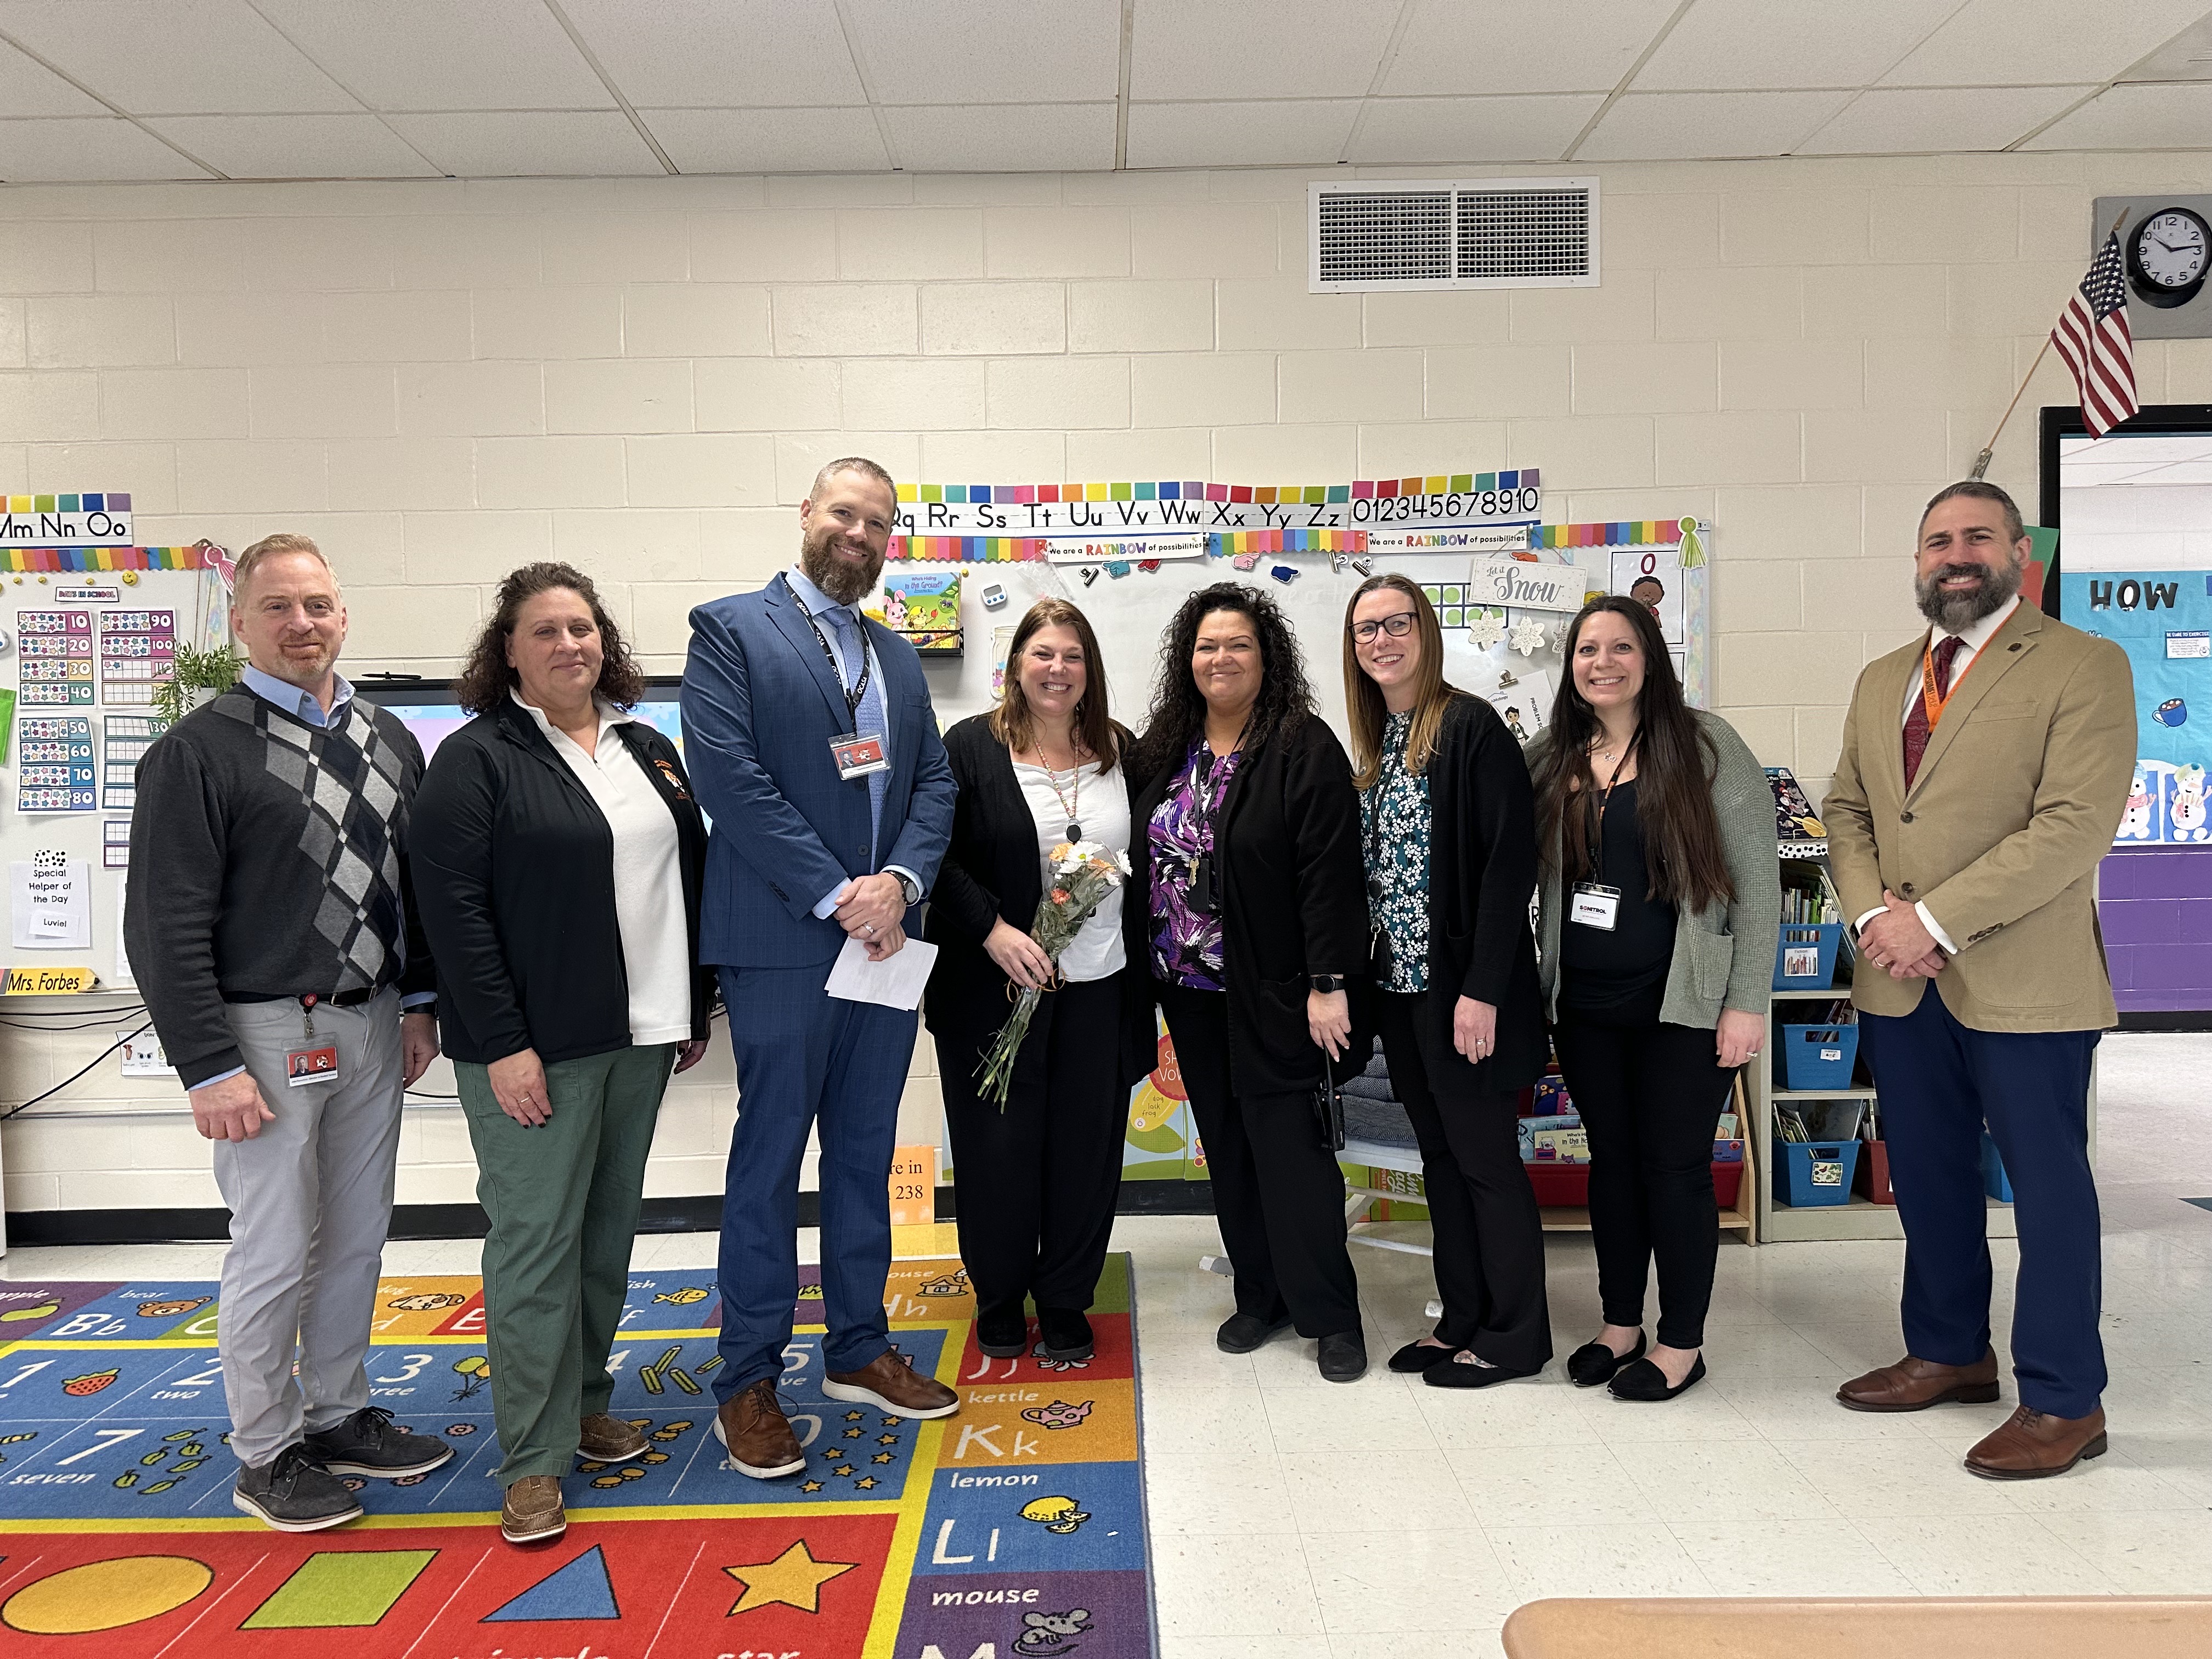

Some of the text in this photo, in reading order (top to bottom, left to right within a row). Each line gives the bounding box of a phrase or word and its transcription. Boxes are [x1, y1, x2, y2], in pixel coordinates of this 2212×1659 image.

[2153, 221, 2160, 229] 11
[2165, 217, 2177, 226] 12
[2142, 232, 2152, 240] 10
[2191, 232, 2199, 240] 2
[2138, 247, 2147, 255] 9
[2142, 261, 2151, 270] 8
[2190, 261, 2198, 269] 4
[2151, 272, 2160, 281] 7
[2165, 276, 2174, 285] 6
[2179, 272, 2187, 281] 5
[929, 503, 960, 527] Rr
[977, 504, 1007, 528] Ss
[1023, 503, 1052, 527] Tt
[1070, 503, 1103, 526] Uu
[1117, 501, 1148, 525] Vv
[1159, 500, 1201, 524] Ww
[1211, 502, 1245, 527] Xx
[1260, 504, 1291, 530] Yy
[1307, 504, 1339, 527] Zz
[41, 513, 76, 537] Nn
[87, 512, 126, 537] Oo
[1406, 534, 1469, 548] RAINBOW
[1480, 534, 1525, 544] possibilities
[1086, 542, 1147, 556] RAINBOW
[1159, 542, 1202, 552] possibilities
[1487, 566, 1498, 577] Let
[1493, 567, 1565, 602] Snow
[2090, 579, 2179, 612] HOW
[71, 614, 87, 628] 10
[151, 614, 171, 628] 90
[69, 639, 90, 652] 20
[153, 640, 173, 650] 100
[70, 662, 91, 675] 30
[857, 676, 867, 694] OCASA
[70, 686, 92, 698] 40
[1530, 697, 1541, 722] PROBLEM
[69, 721, 87, 733] 50
[71, 744, 90, 757] 60
[74, 768, 92, 781] 70
[72, 792, 93, 804] 80
[33, 869, 66, 879] Special
[29, 882, 59, 891] Helper
[52, 895, 68, 904] Day
[8, 973, 80, 991] Mrs. Forbes
[889, 1160, 923, 1175] re in
[896, 1185, 923, 1199] 238
[118, 1290, 170, 1299] bear
[49, 1313, 126, 1335] Bb
[374, 1354, 433, 1383] 3
[150, 1390, 201, 1399] two
[369, 1384, 416, 1396] ree
[968, 1390, 1039, 1404] kettle
[55, 1429, 146, 1466] 7
[953, 1424, 1039, 1459] Kk
[9, 1474, 96, 1485] seven
[951, 1472, 1039, 1488] lemon
[932, 1589, 1039, 1606] mouse
